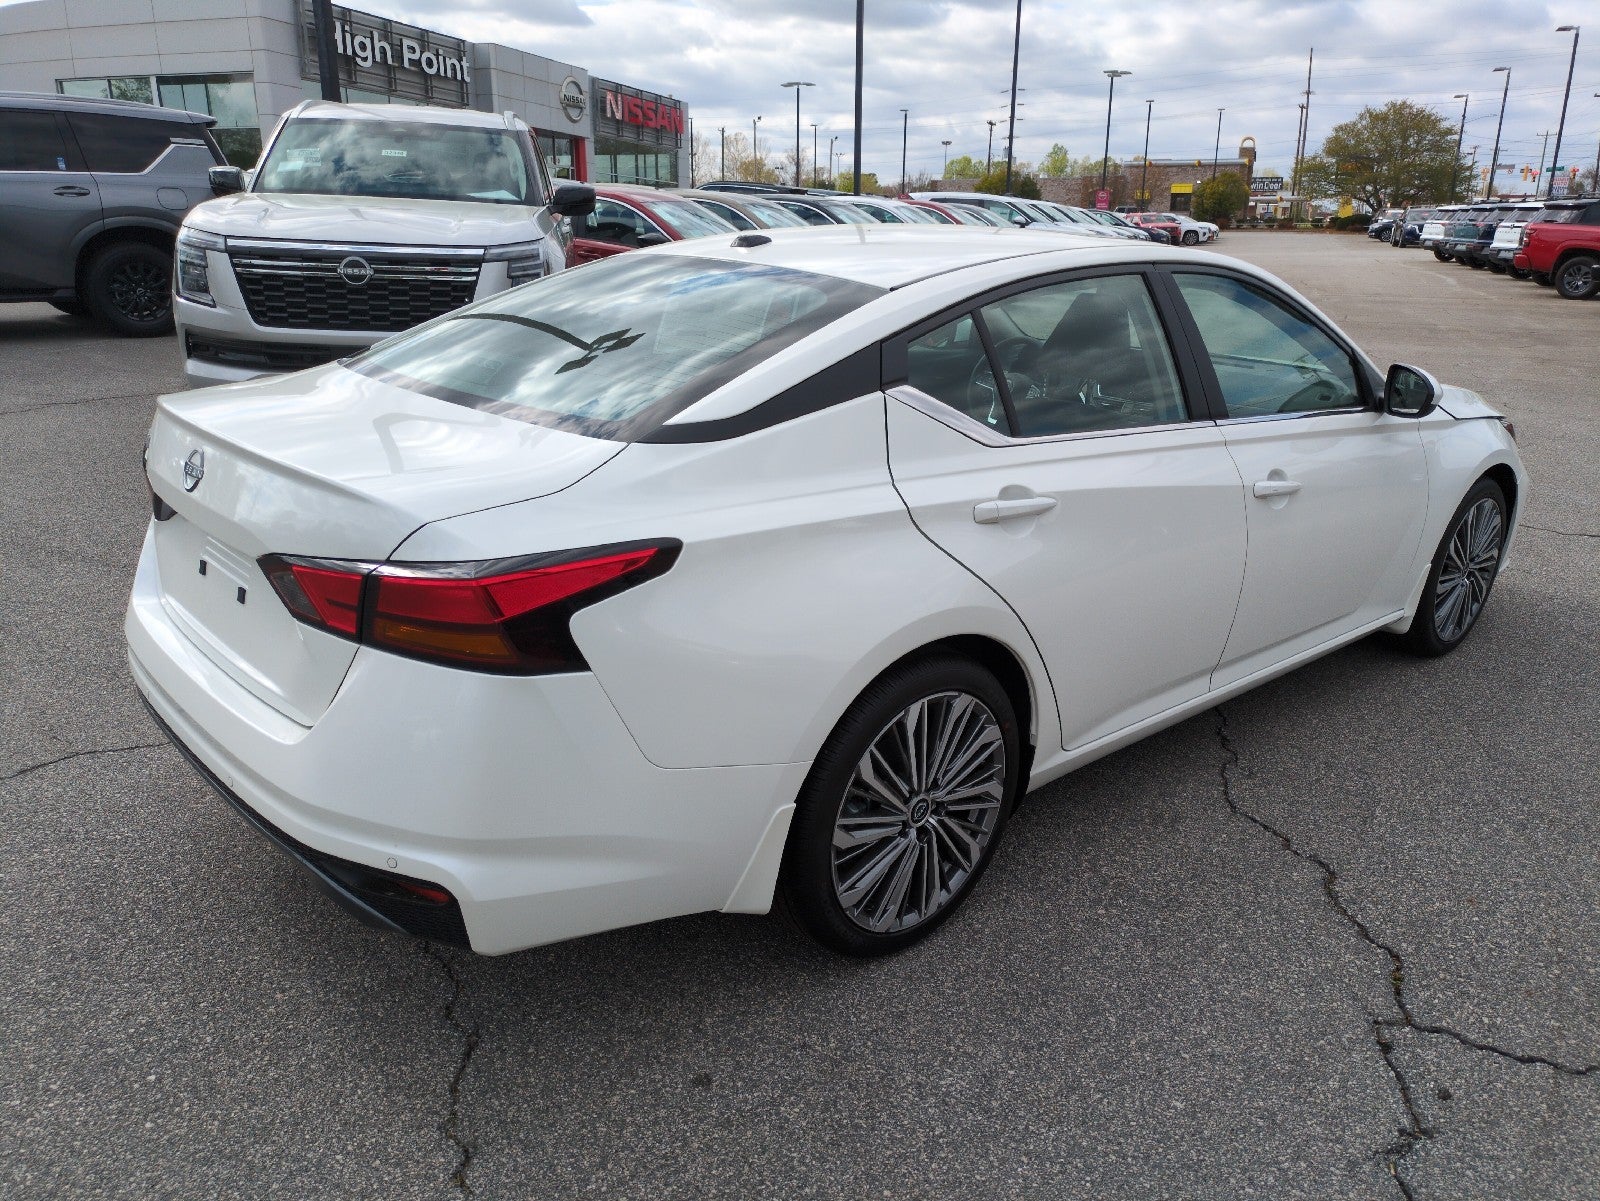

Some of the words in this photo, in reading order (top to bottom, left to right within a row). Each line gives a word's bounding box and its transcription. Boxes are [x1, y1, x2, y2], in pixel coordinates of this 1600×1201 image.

[402, 37, 471, 82] Point
[606, 90, 684, 135] NISSAN
[337, 267, 374, 275] NISSAN
